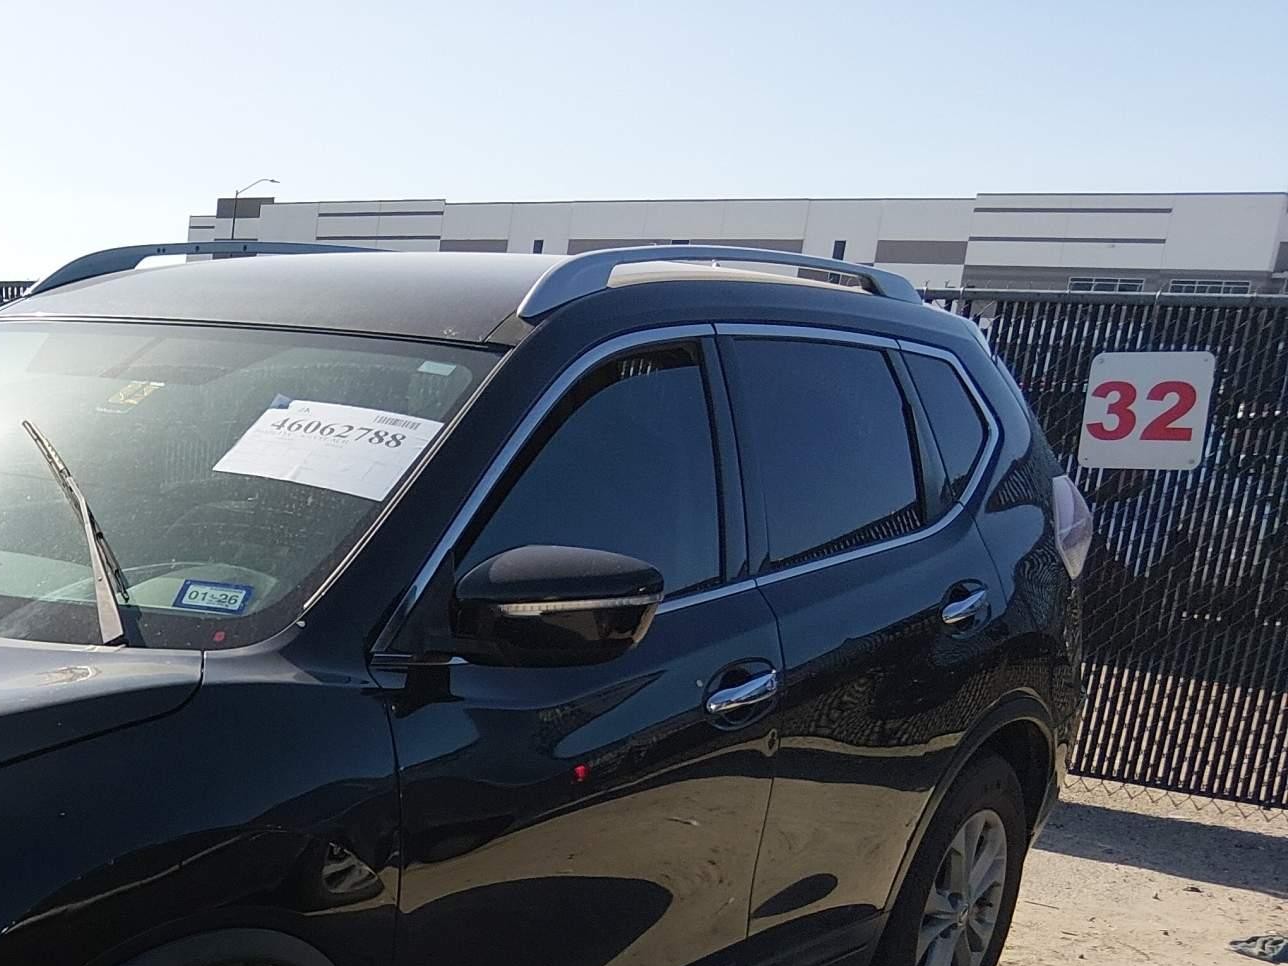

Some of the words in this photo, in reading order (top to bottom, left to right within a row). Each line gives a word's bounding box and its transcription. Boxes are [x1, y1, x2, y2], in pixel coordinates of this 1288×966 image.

[1086, 381, 1197, 441] 32
[271, 417, 407, 449] 46062788
[188, 590, 209, 602] 01
[219, 593, 239, 606] 26
